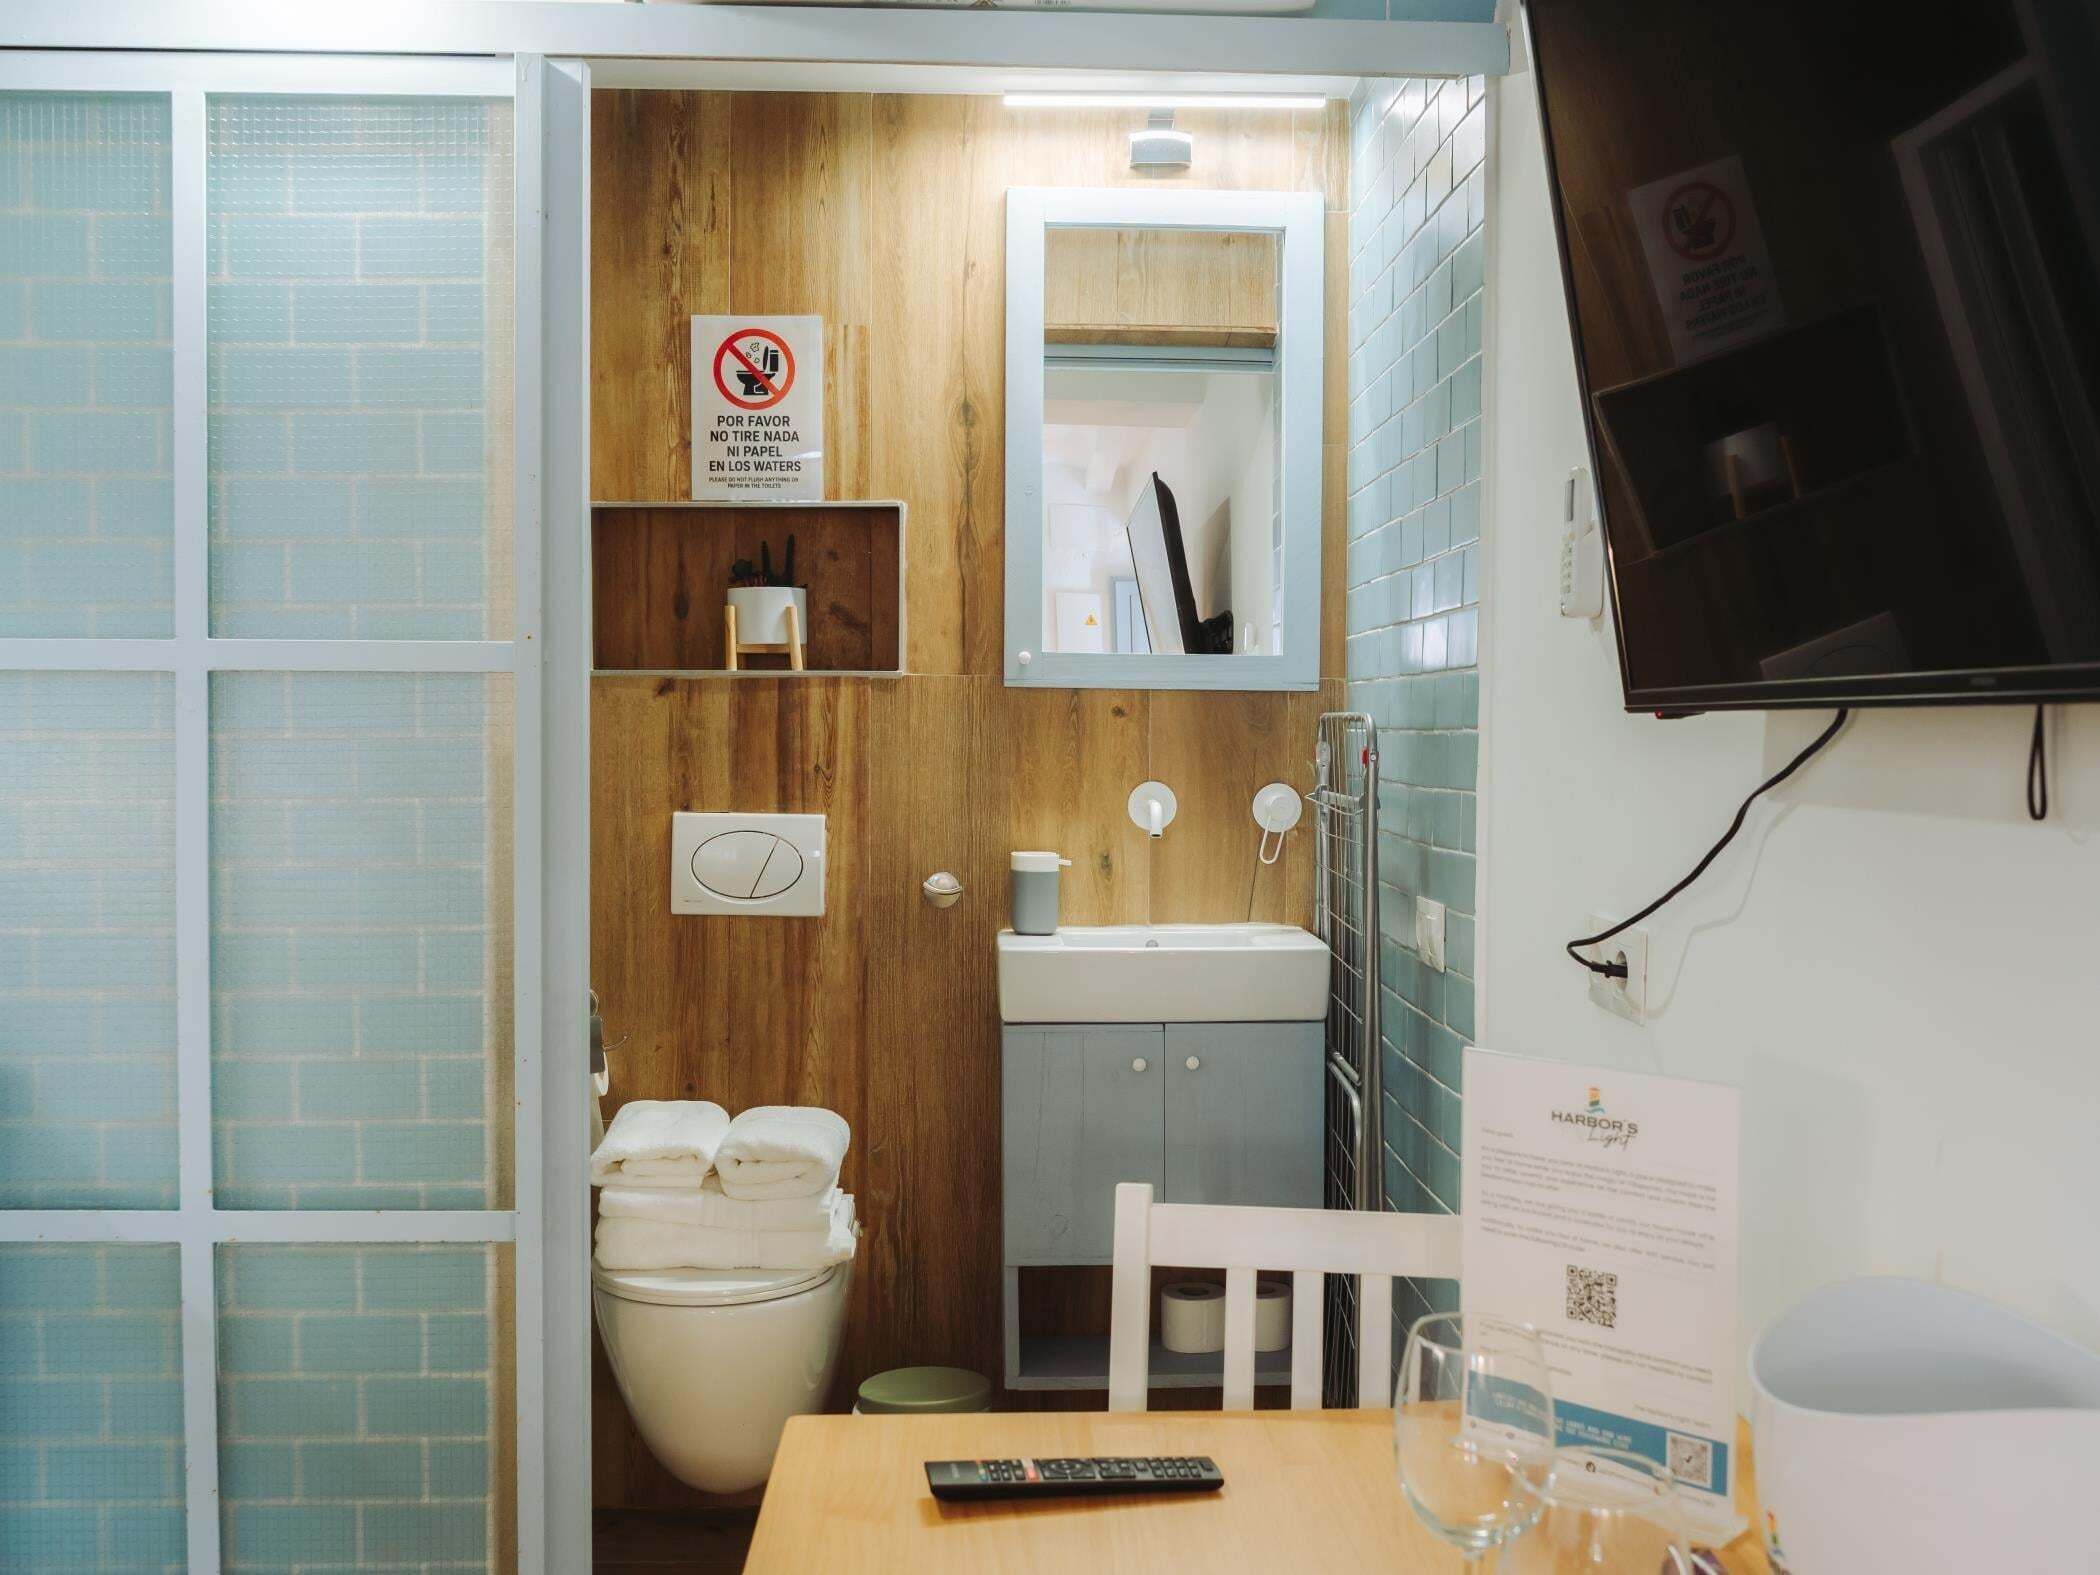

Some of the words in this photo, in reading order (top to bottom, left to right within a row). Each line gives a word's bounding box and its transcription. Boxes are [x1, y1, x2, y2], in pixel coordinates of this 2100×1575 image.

[717, 415, 744, 427] POR
[748, 415, 790, 427] FAVOR
[710, 430, 729, 442] NO
[732, 430, 760, 442] TIRE
[764, 430, 800, 442] NADA
[727, 446, 740, 457] NI
[744, 446, 783, 457] PAPEL
[709, 461, 725, 472] EN
[729, 461, 751, 472] LOS
[754, 461, 801, 472] WATERS
[1587, 1130, 1635, 1152] Light
